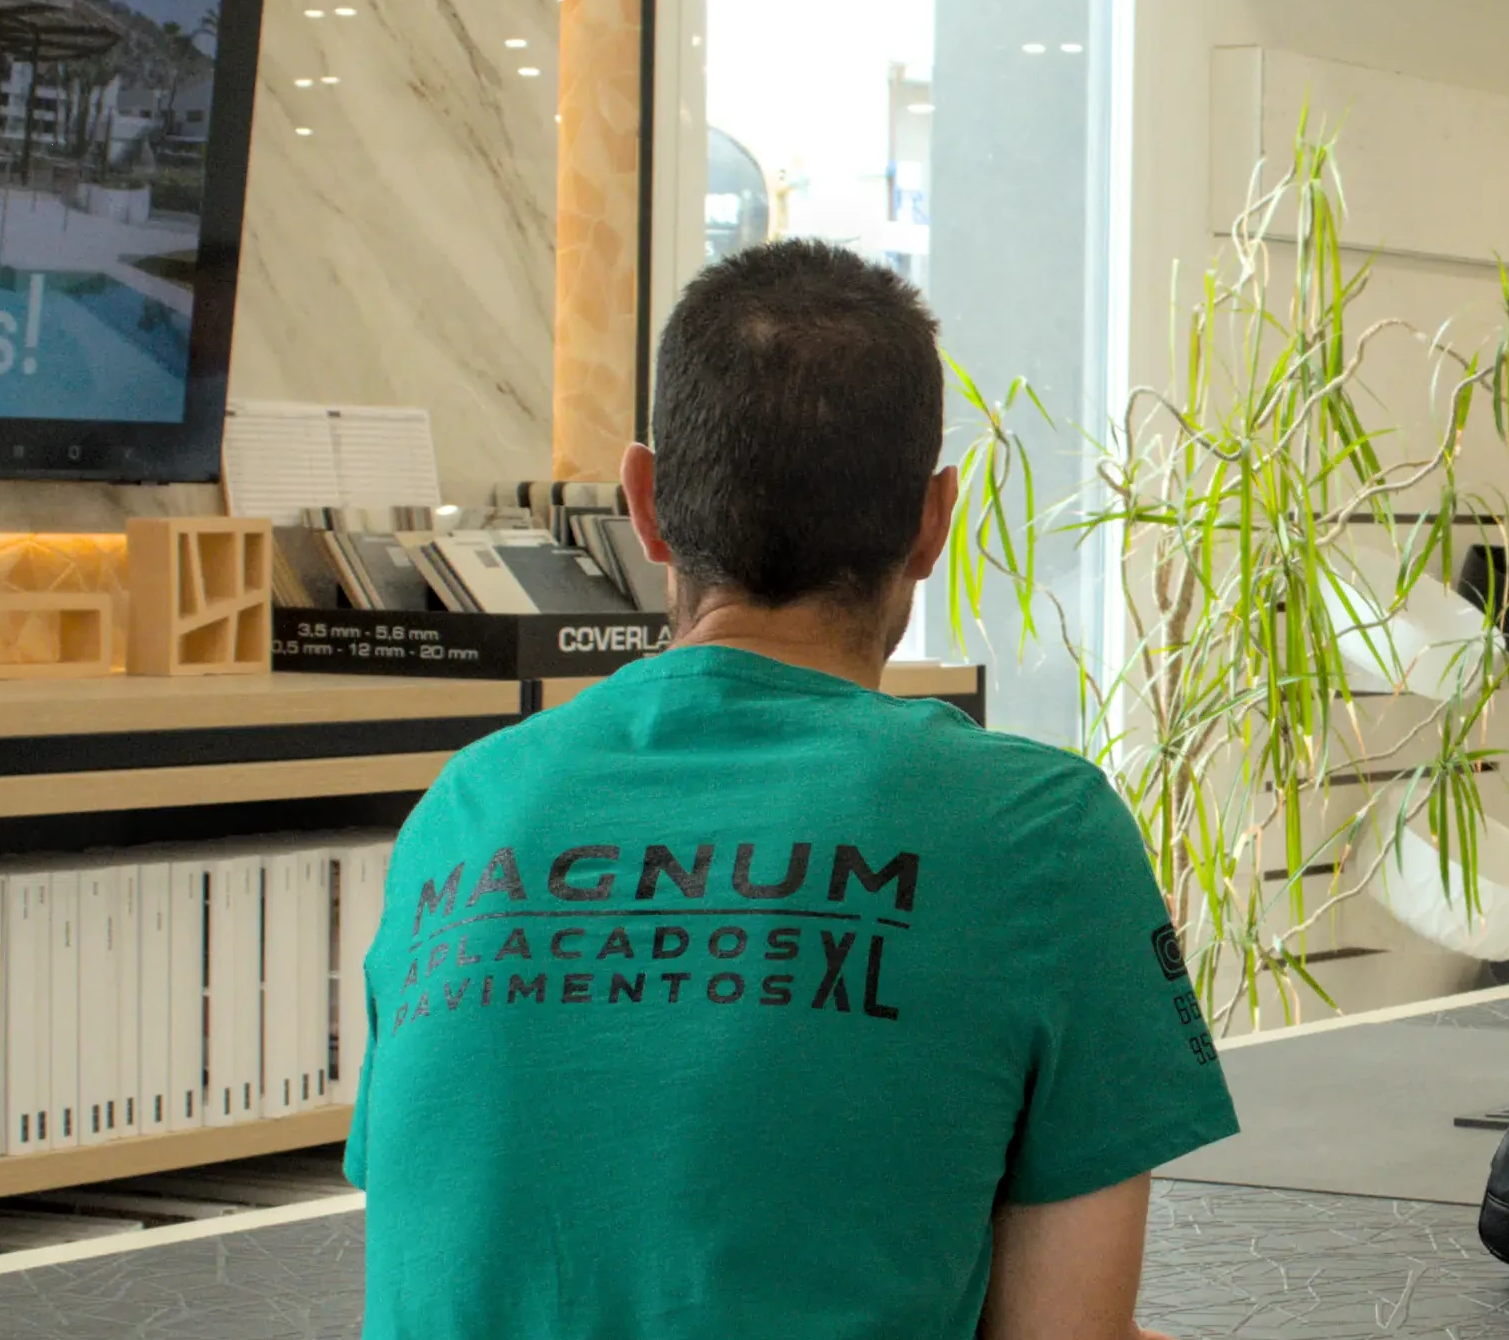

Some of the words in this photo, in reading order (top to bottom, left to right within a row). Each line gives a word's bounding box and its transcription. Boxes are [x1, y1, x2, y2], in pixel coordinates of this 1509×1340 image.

[270, 640, 300, 656] 0,5
[302, 643, 333, 655] mm
[349, 642, 372, 658] 12
[375, 645, 405, 658] mm
[419, 645, 444, 660] 20
[448, 647, 480, 660] mm
[331, 626, 361, 638] mm
[408, 628, 440, 641] mm
[559, 625, 672, 652] COVERLA
[412, 842, 920, 936] MAGNUM
[400, 926, 801, 995] APLACADOS
[810, 928, 899, 1021] XL
[393, 971, 794, 1038] PAVIMENTOS
